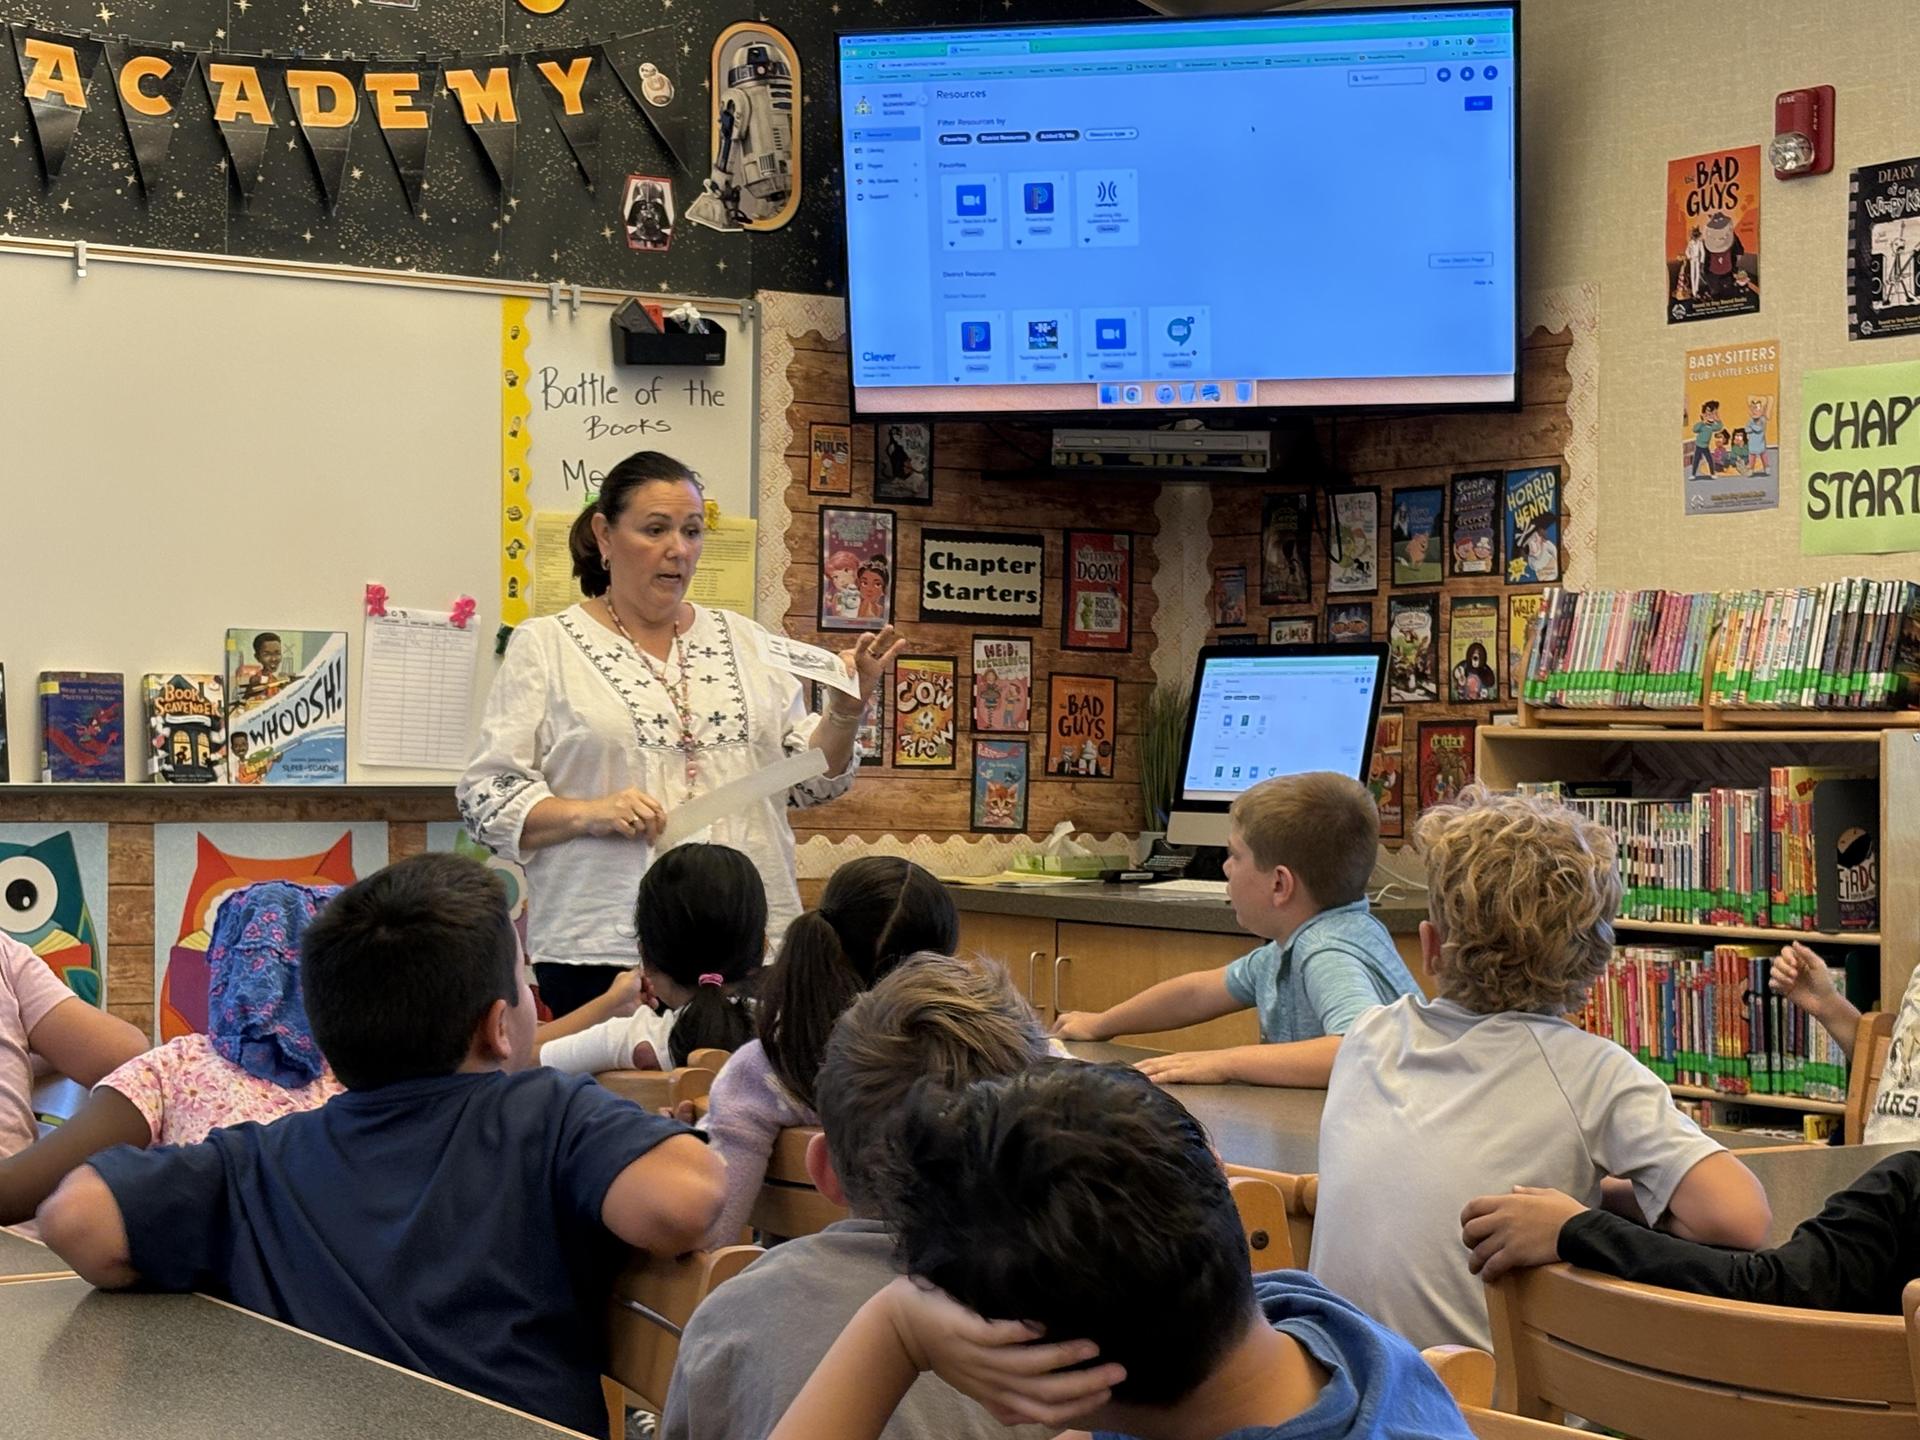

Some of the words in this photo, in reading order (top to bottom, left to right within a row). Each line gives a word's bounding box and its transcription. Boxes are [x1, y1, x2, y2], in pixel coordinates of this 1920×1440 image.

[24, 38, 593, 130] ACADEMY
[936, 90, 987, 99] Resources
[1695, 156, 1740, 189] BAD
[1878, 164, 1918, 184] DIARY
[1686, 182, 1740, 218] GUYS
[862, 351, 897, 363] Clever
[1689, 345, 1776, 369] BABY-SITTERS
[539, 366, 620, 411] Battle
[634, 375, 664, 406] of
[682, 378, 726, 407] the
[583, 413, 672, 441] Books
[1808, 395, 1920, 452] CHAP
[1514, 489, 1554, 531] HENRY
[929, 551, 1037, 576] Chapter
[1076, 560, 1121, 582] DOOM
[926, 580, 1038, 604] Starters
[248, 655, 342, 746] WHOOSH!
[1067, 694, 1105, 717] BAD
[1058, 714, 1106, 740] GUYS
